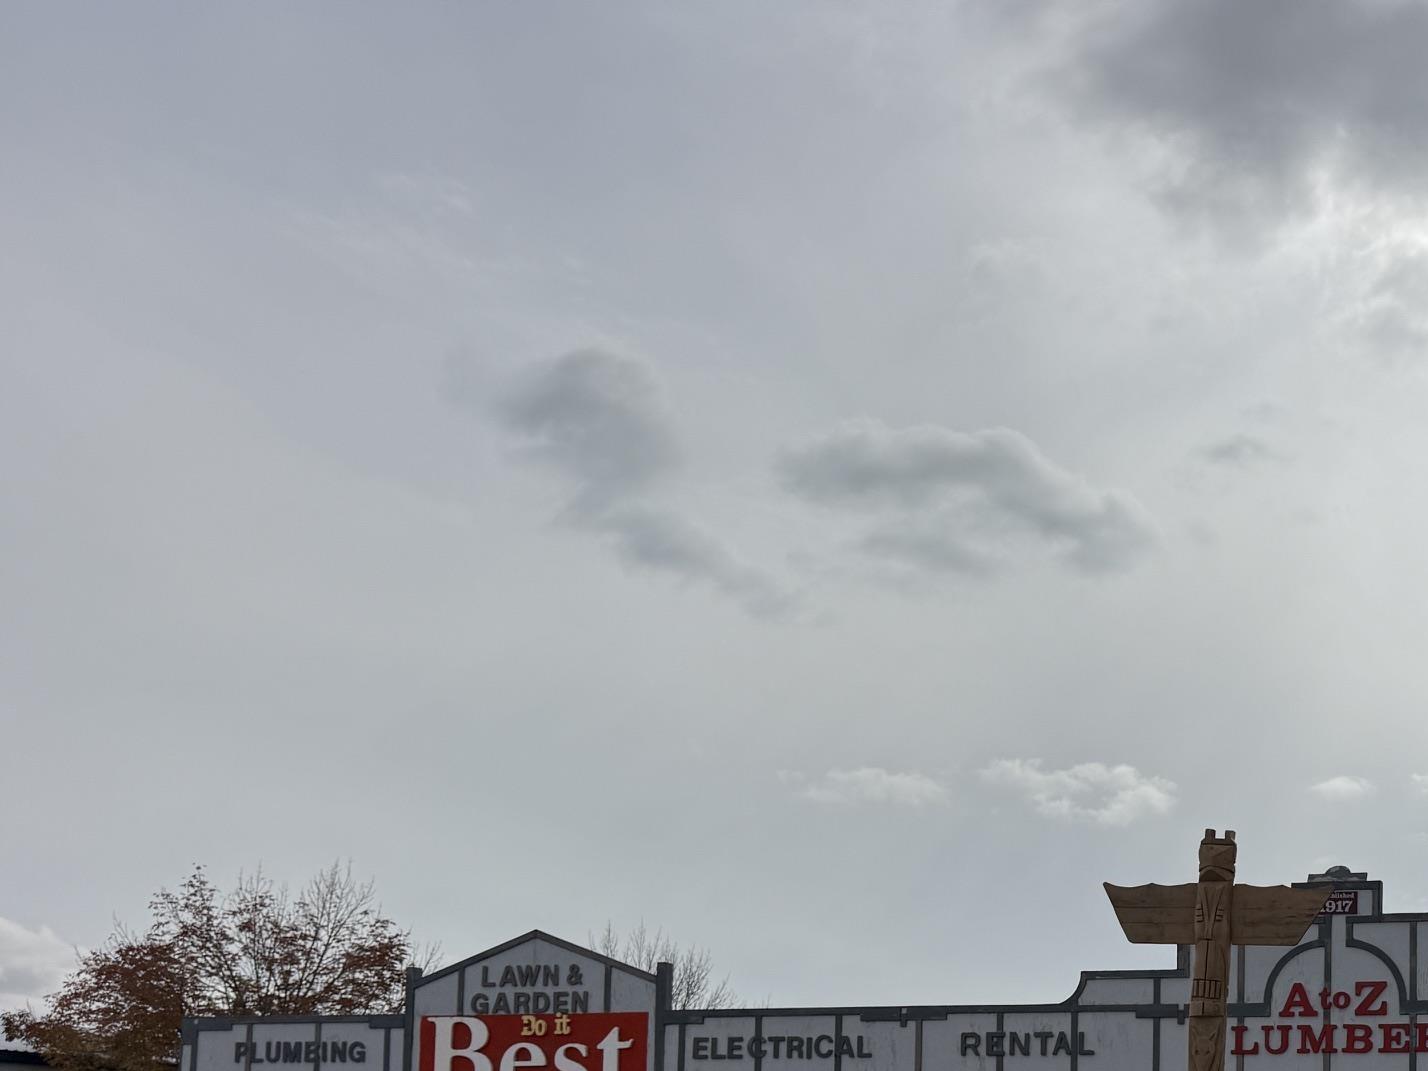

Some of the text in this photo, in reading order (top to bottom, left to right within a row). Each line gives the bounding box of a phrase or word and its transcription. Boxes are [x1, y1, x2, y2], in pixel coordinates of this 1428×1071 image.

[1320, 900, 1354, 913] 917
[481, 963, 584, 987] LAWN &
[470, 991, 589, 1014] GARDEN
[521, 1013, 571, 1036] Do it
[234, 1041, 367, 1063] PLUMBING
[692, 1034, 873, 1060] ELECTRICAL
[960, 1031, 1096, 1057] RENTAL
